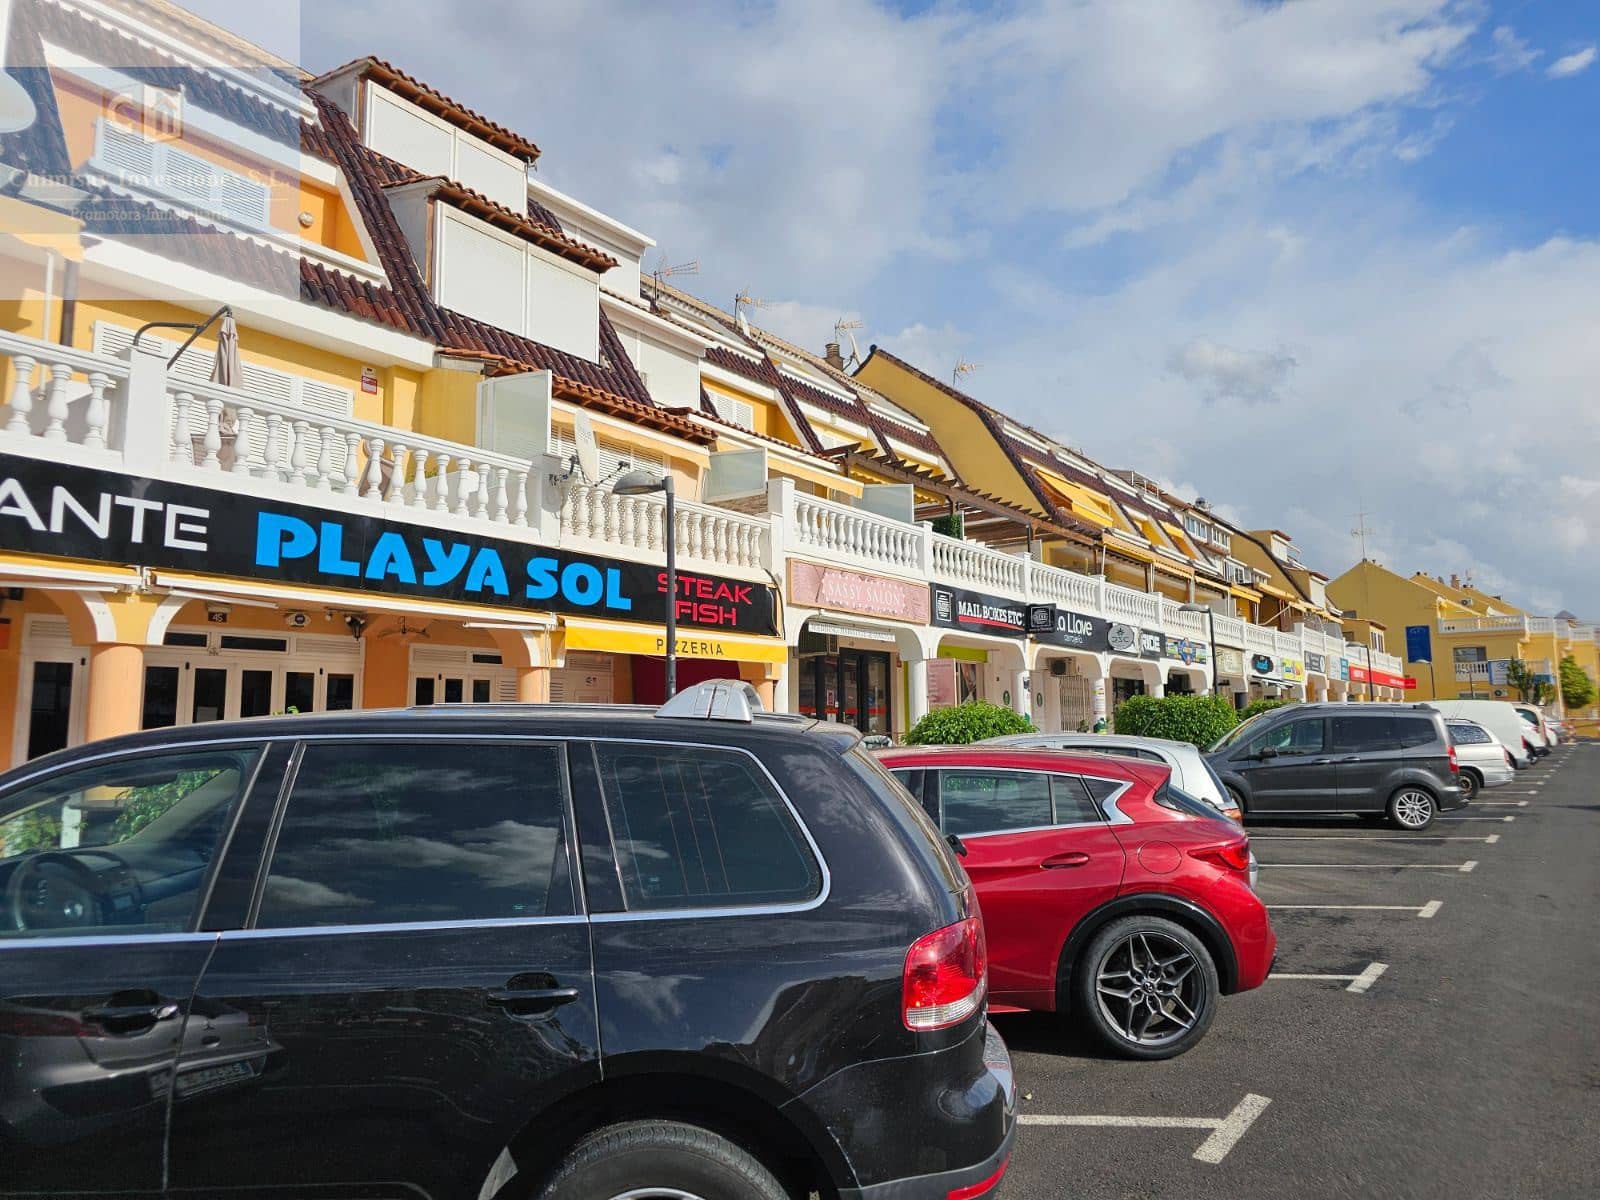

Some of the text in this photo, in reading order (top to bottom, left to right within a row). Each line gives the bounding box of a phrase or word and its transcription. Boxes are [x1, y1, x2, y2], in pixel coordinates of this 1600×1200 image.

[0, 477, 632, 611] ANTE PLAYA SOL
[657, 573, 752, 605] STEAK
[675, 600, 737, 626] FISH
[958, 600, 982, 618] MAIL
[982, 605, 1007, 624] BOXES
[1067, 613, 1093, 636] Llave
[656, 638, 724, 656] PZERIA
